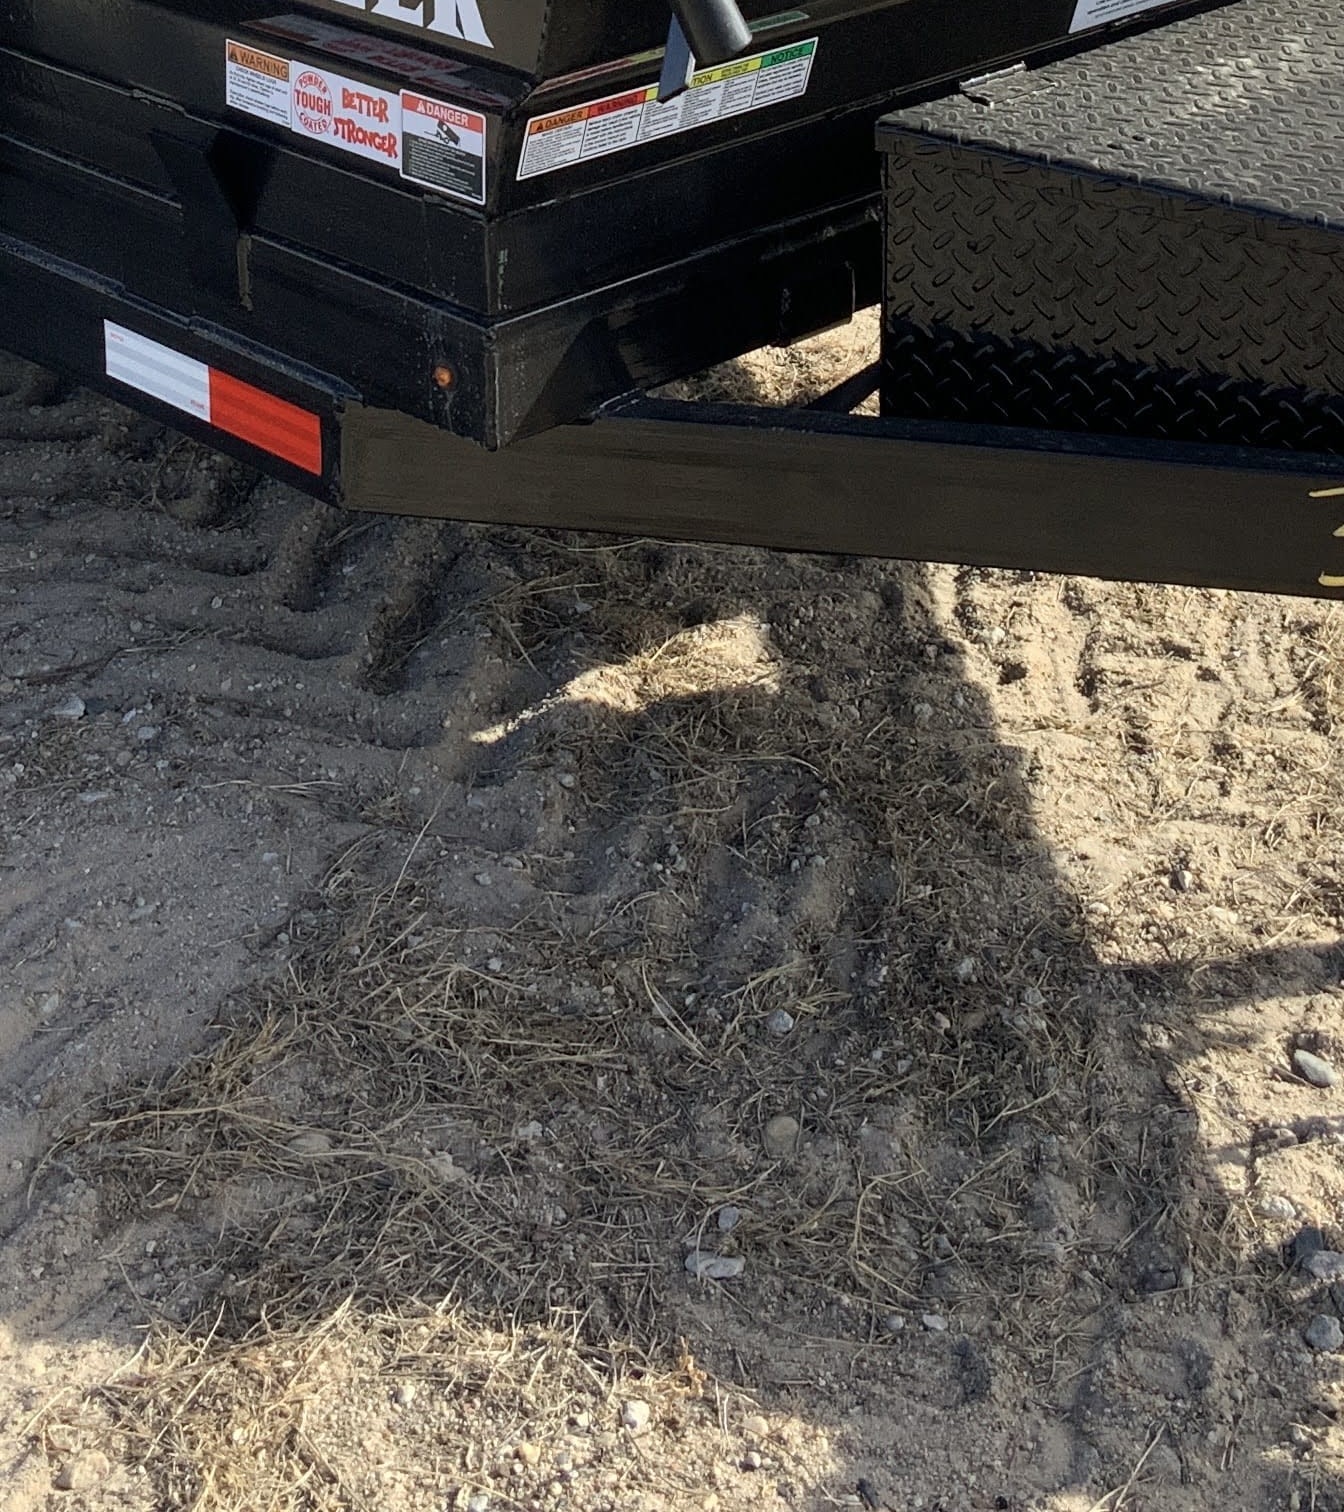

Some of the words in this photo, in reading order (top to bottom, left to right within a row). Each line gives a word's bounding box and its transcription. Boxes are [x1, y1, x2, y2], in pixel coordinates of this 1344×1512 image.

[238, 49, 289, 78] WARNING
[770, 48, 805, 64] NOTICE
[294, 88, 331, 117] TOUGH
[342, 87, 389, 124] BETTER
[426, 102, 469, 127] DANGER
[545, 110, 583, 129] DANGER
[333, 117, 399, 160] STRONGER
